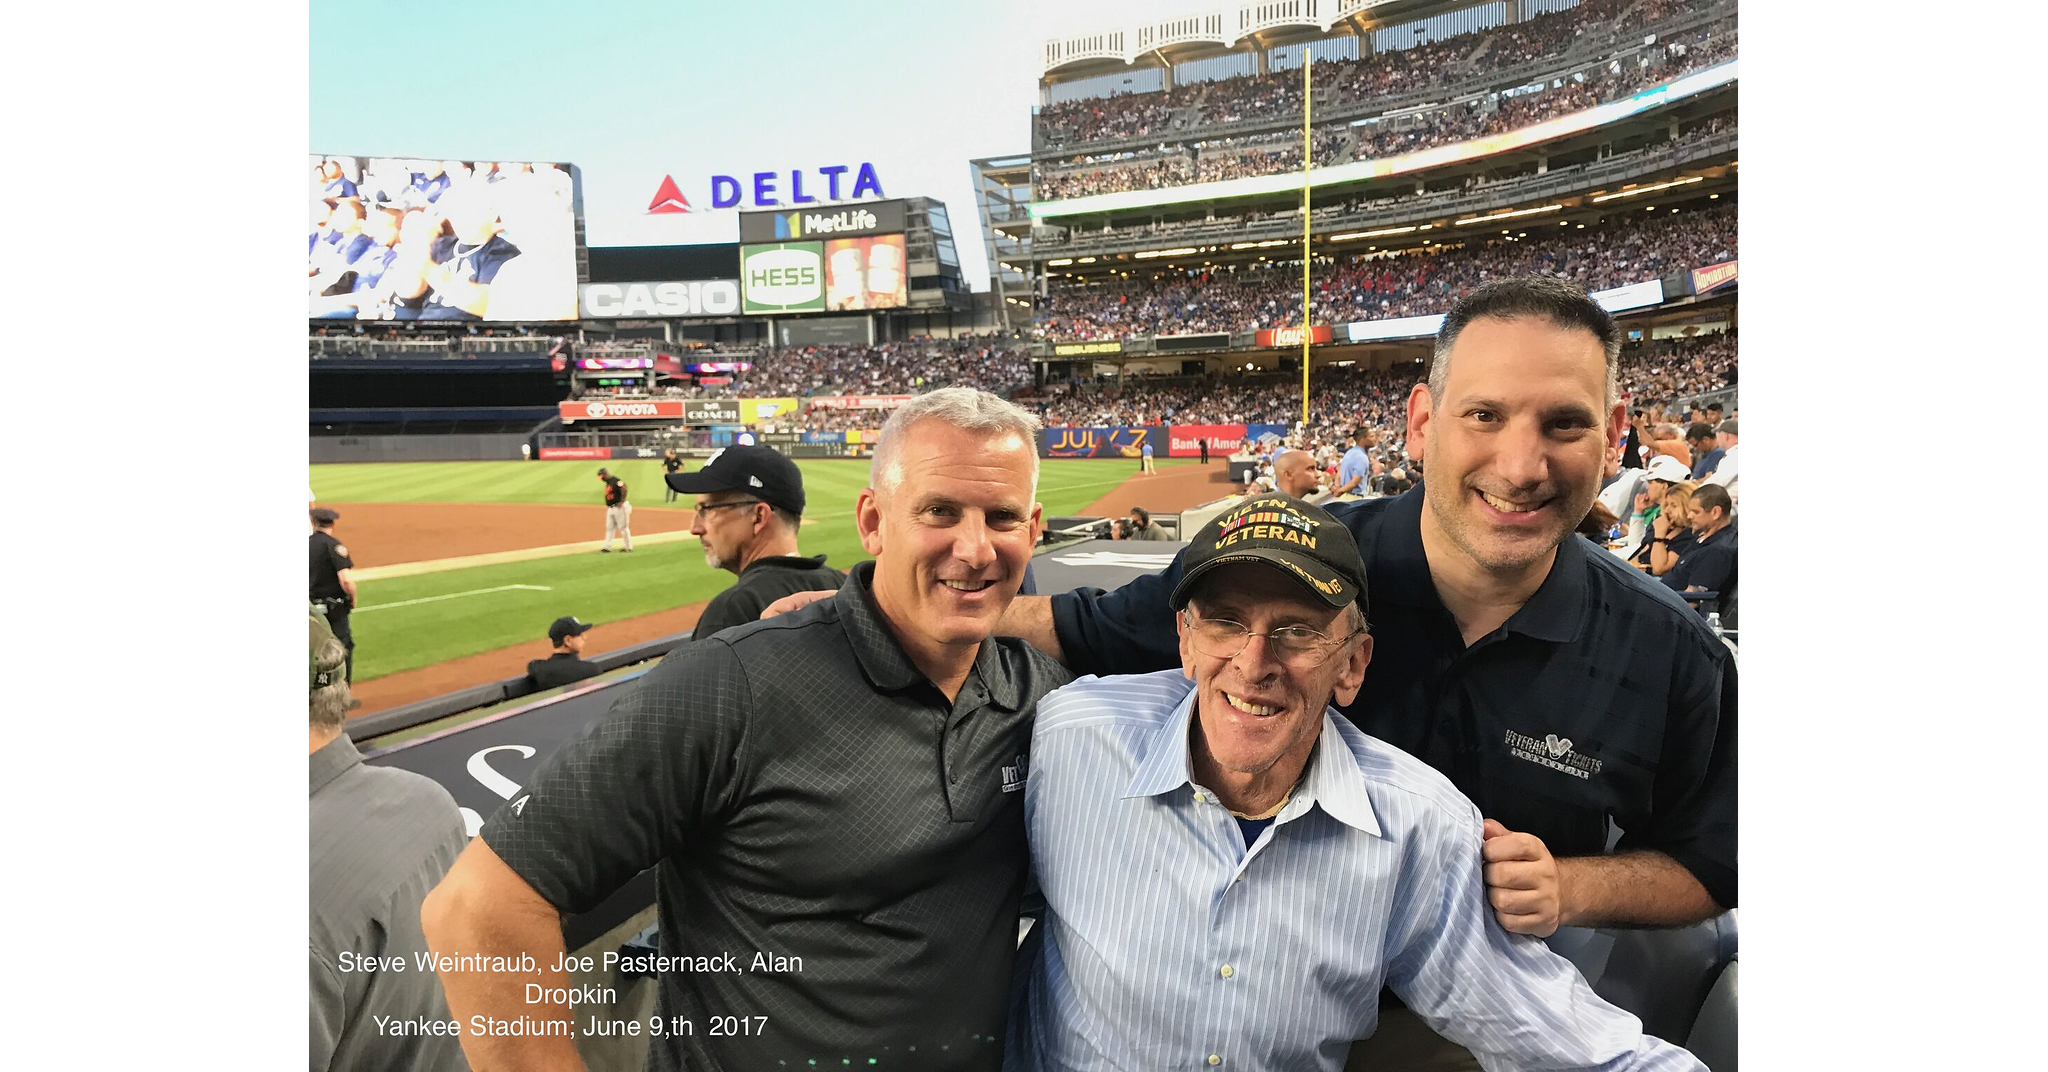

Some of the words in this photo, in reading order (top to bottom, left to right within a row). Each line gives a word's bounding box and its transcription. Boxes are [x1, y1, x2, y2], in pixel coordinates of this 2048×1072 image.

[711, 162, 885, 208] DELTA
[804, 209, 877, 234] MetLife
[751, 266, 815, 287] HESS
[585, 280, 738, 317] CASIO
[606, 403, 658, 416] TOYOTA
[687, 410, 737, 420] COACH
[1128, 429, 1147, 449] 7
[1217, 499, 1321, 529] VIETNAM
[1215, 524, 1317, 550] VETERAN
